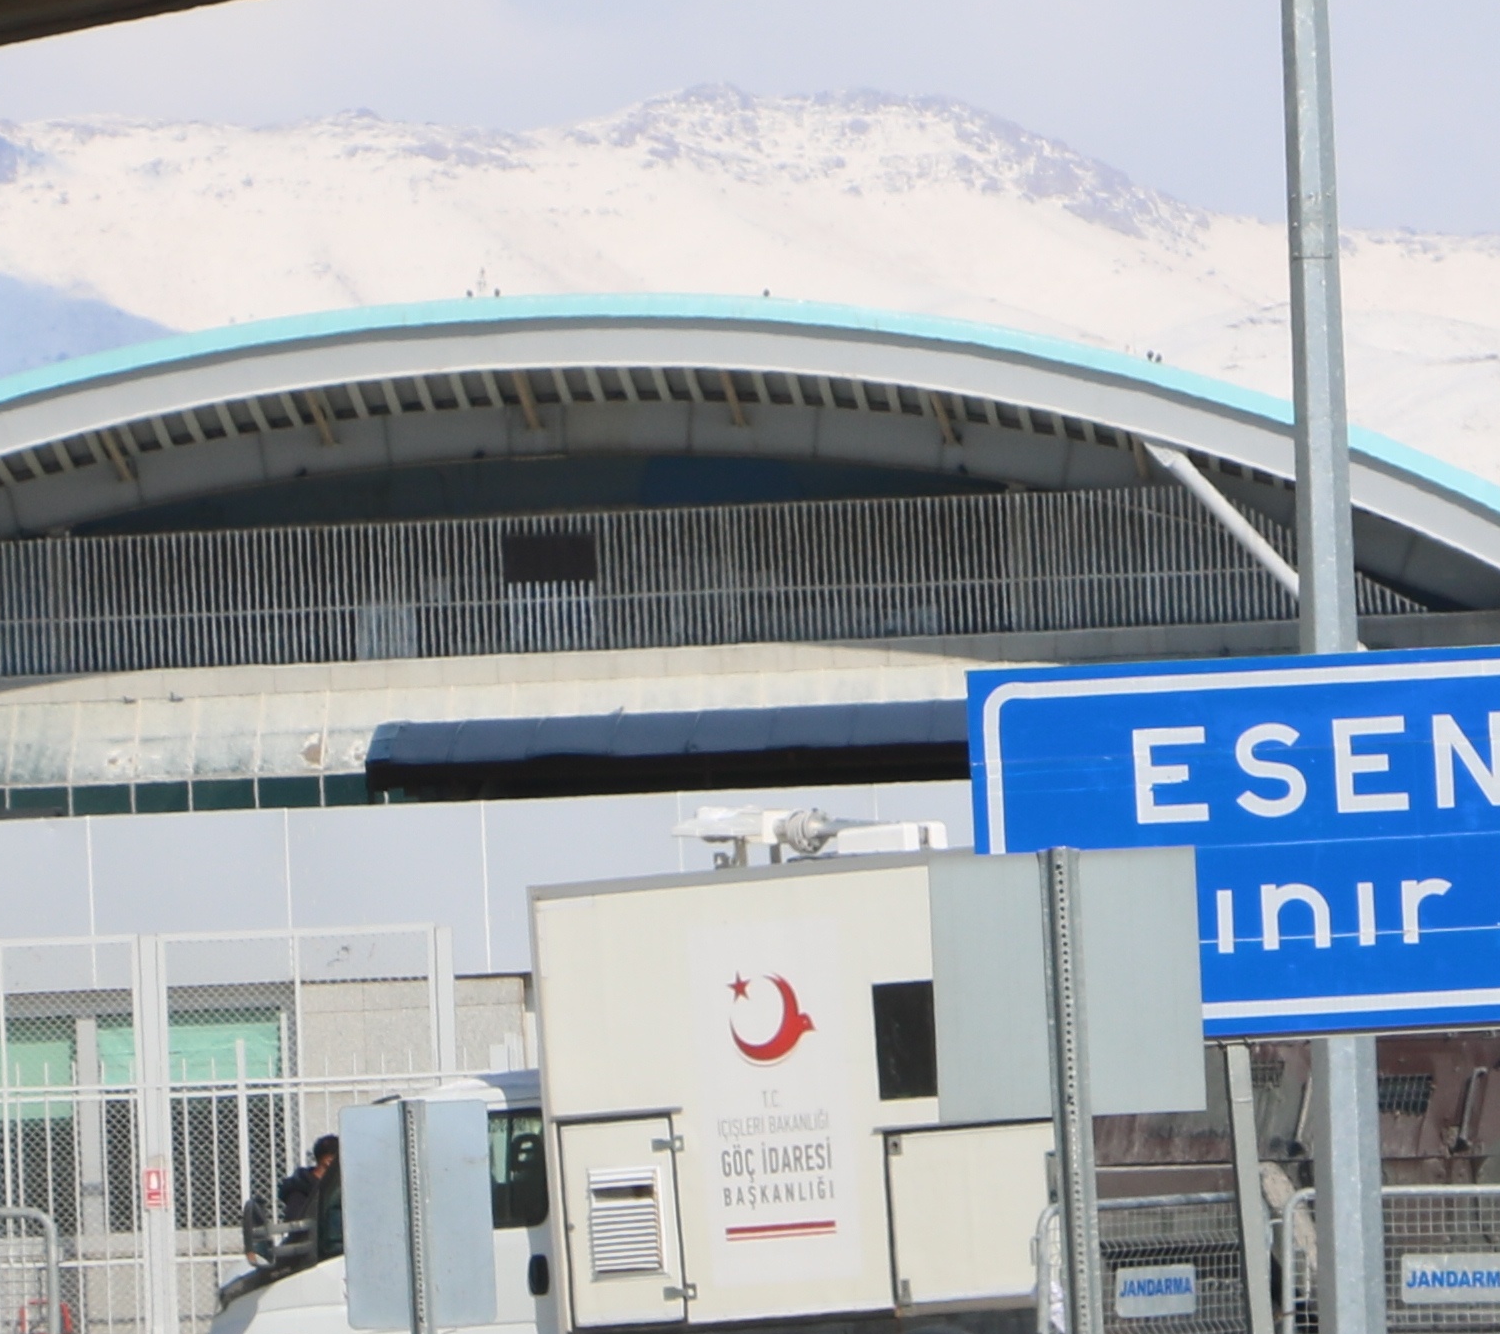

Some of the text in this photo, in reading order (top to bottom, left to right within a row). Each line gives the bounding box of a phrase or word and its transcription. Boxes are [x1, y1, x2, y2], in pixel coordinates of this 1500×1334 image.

[1215, 874, 1454, 955] ınır
[720, 1135, 833, 1185] GÖÇ İDARESİ
[722, 1175, 836, 1211] BAŞKANLIĞI
[1119, 1276, 1193, 1299] JANDARMA
